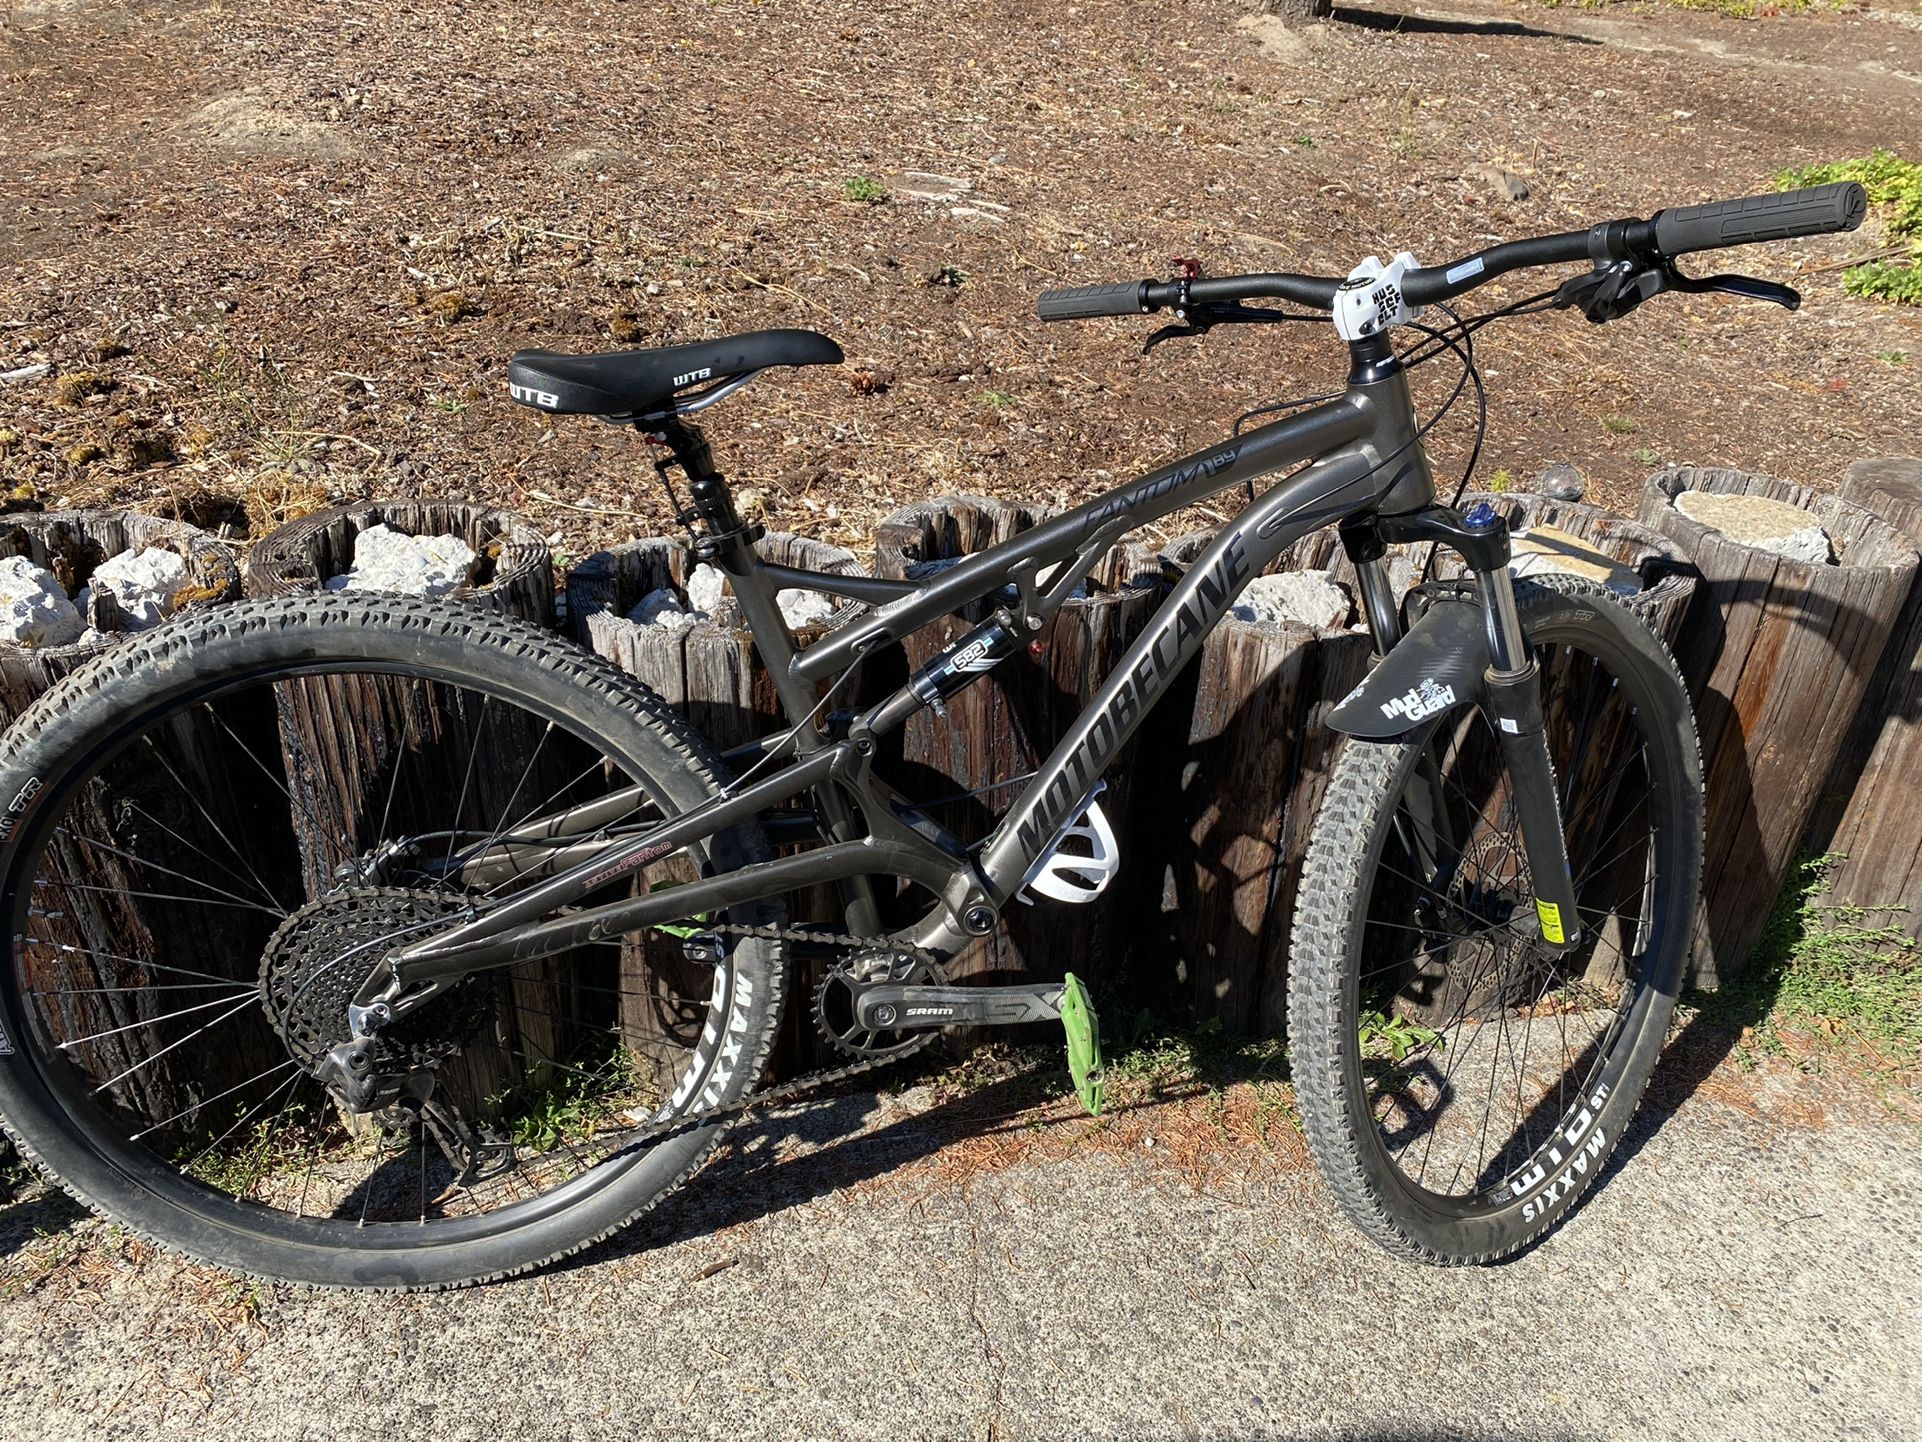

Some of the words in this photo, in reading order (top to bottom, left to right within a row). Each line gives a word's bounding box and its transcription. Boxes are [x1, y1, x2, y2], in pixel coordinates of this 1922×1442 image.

[1372, 284, 1396, 305] HUS
[673, 367, 711, 387] WTB
[510, 383, 558, 408] WTB
[1083, 462, 1209, 532] FANTOM
[953, 644, 984, 669] 582
[1016, 531, 1250, 860] MOTOBECANE
[1380, 688, 1421, 719] Mud
[1405, 684, 1456, 721] Guard
[9, 777, 42, 812] TR
[906, 1007, 953, 1016] SRAM
[1523, 1127, 1606, 1222] MAXXIS
